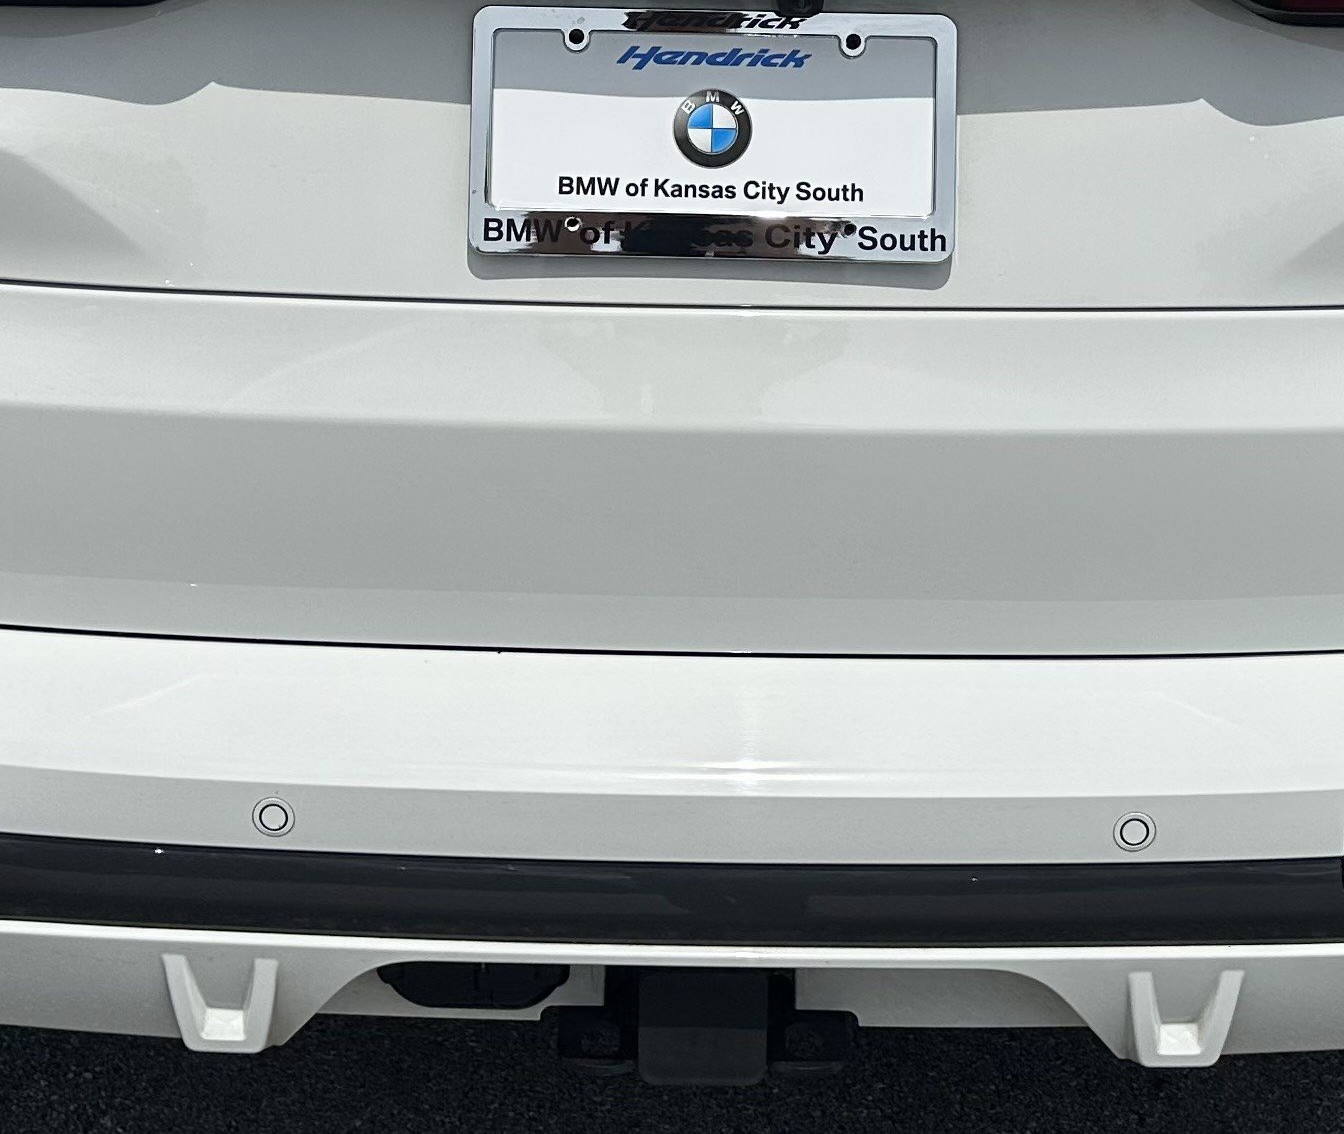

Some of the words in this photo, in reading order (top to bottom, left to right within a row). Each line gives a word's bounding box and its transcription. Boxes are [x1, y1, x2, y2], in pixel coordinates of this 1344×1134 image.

[617, 45, 812, 70] Hendrick
[681, 91, 745, 115] BMW
[558, 176, 620, 196] BMW
[625, 179, 648, 198] of
[654, 178, 737, 200] Kansas
[743, 180, 790, 204] City
[796, 181, 864, 202] South
[483, 218, 564, 243] BMW
[579, 220, 613, 245] of
[623, 220, 754, 247] Kas
[765, 224, 839, 255] City
[858, 226, 947, 252] South
